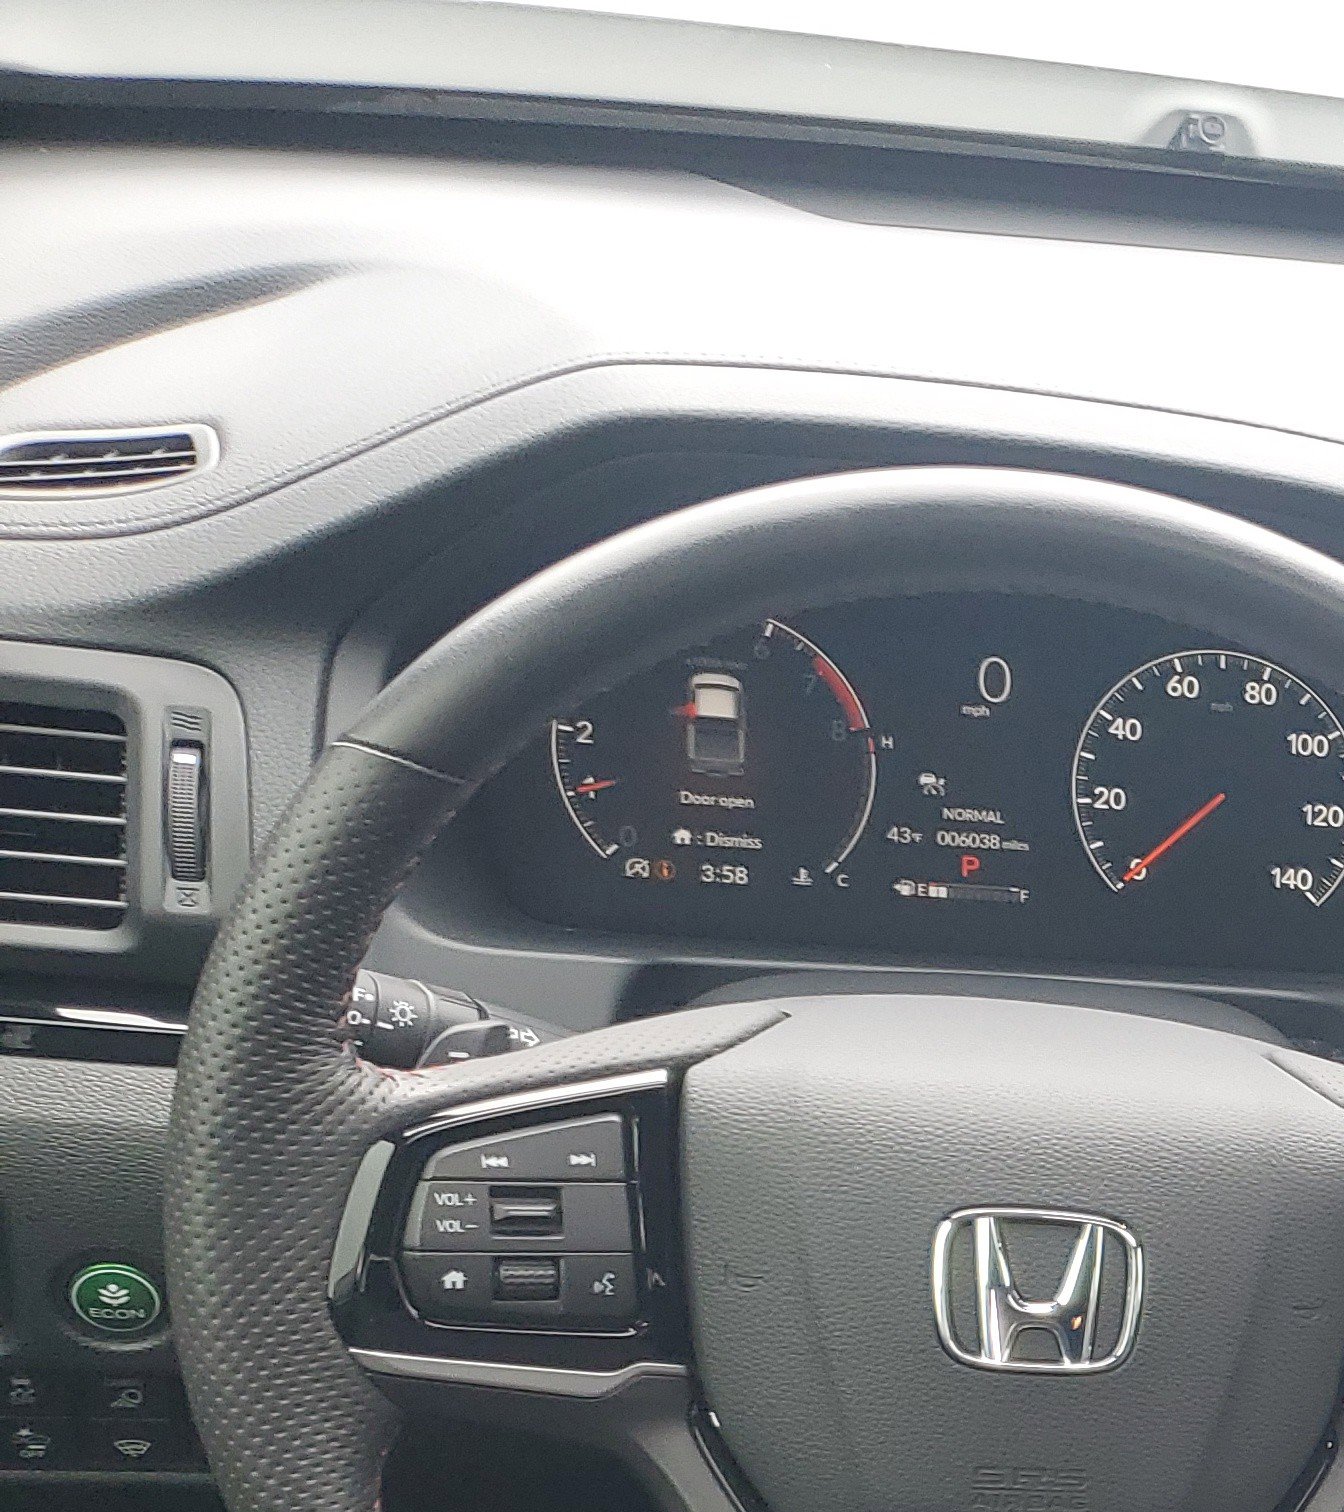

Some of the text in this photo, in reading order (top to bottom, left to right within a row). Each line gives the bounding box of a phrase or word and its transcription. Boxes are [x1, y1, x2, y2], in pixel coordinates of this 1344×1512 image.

[978, 655, 1011, 703] 0
[1165, 675, 1200, 699] 60
[1244, 681, 1278, 706] 80
[575, 720, 595, 744] 2
[1107, 717, 1143, 741] 40
[1286, 732, 1330, 758] 100
[680, 790, 755, 810] Door open
[1093, 786, 1127, 811] 20
[942, 807, 1006, 825] NORMAL
[1302, 803, 1344, 828] 120
[705, 831, 763, 850] Dismiss
[701, 864, 749, 885] 3:58
[961, 854, 981, 878] P
[835, 873, 850, 888] C
[1271, 867, 1314, 892] 140
[88, 1307, 147, 1320] ECON
